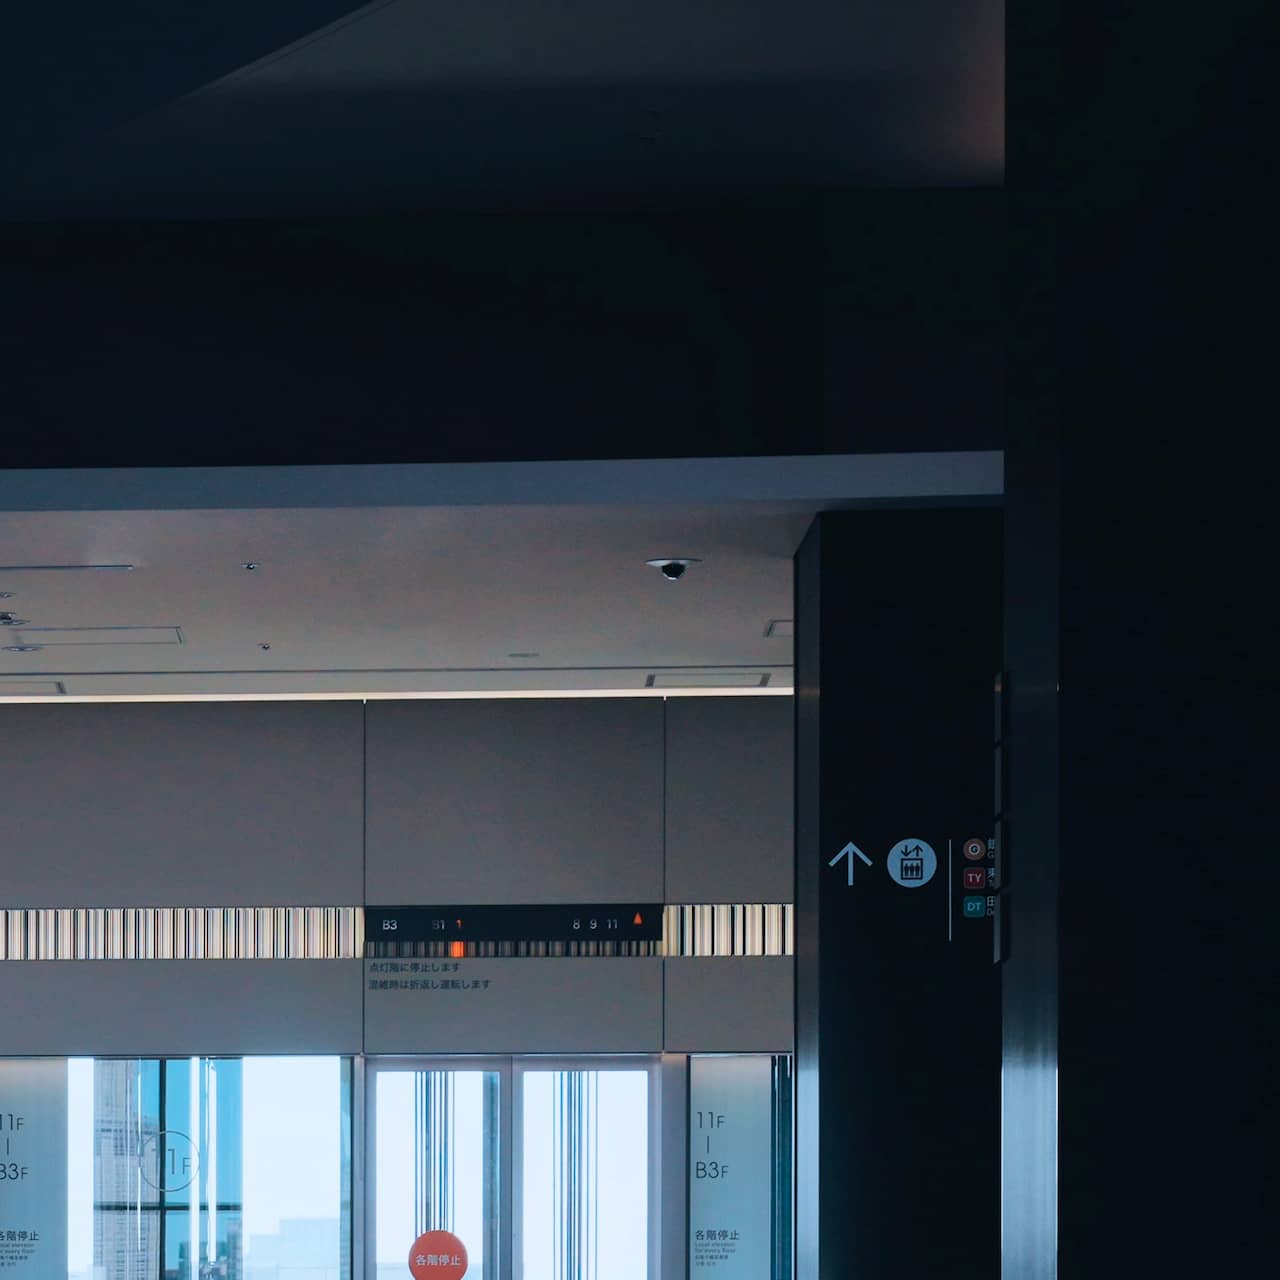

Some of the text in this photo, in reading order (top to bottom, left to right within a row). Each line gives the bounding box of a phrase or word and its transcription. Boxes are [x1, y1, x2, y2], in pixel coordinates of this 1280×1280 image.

[968, 873, 982, 883] TY
[967, 902, 982, 912] DT
[382, 920, 398, 930] B3
[573, 919, 581, 930] 8
[589, 919, 598, 930] 9
[607, 919, 618, 929] 11
[696, 1111, 725, 1129] 11F
[695, 1161, 729, 1179] B3F
[695, 1230, 739, 1241] 各階停止
[416, 1254, 461, 1266] 各階停止
